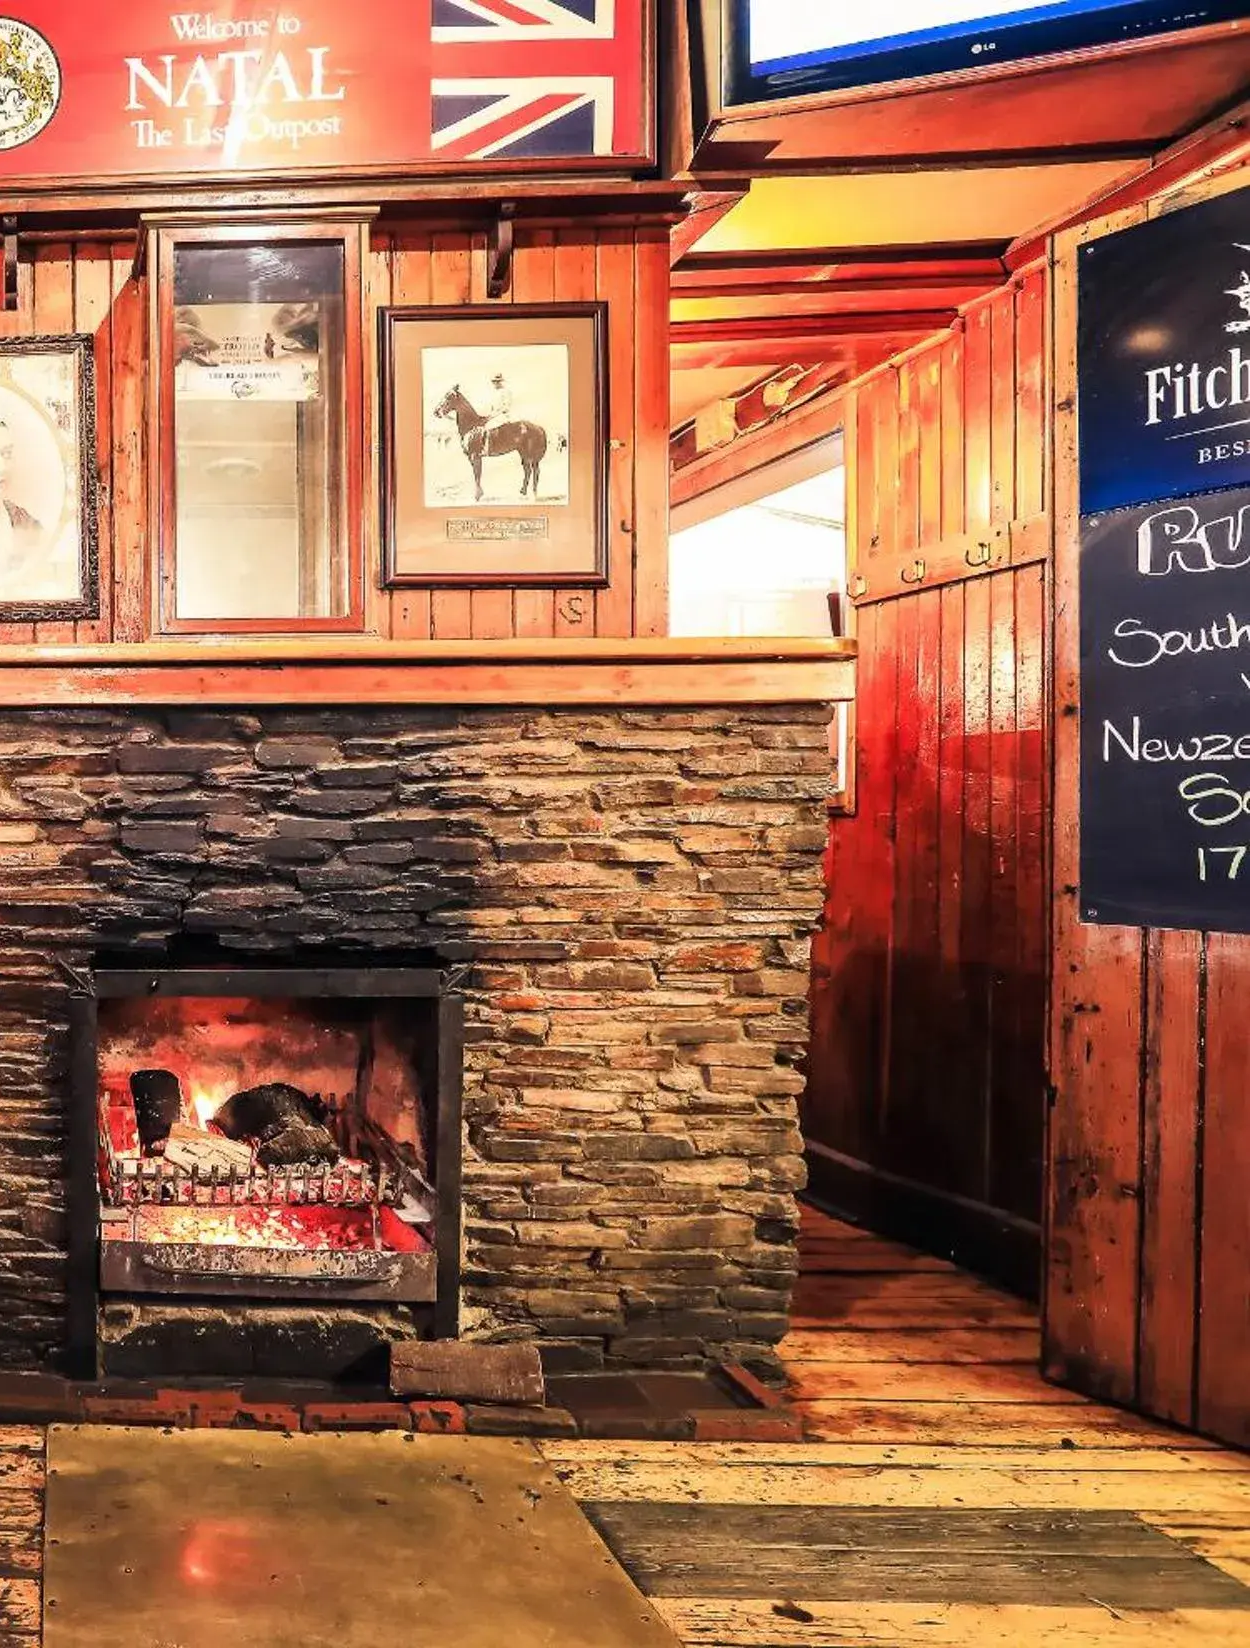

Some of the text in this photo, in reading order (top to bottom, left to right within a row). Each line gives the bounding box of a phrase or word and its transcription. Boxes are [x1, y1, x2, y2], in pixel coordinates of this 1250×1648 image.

[170, 12, 301, 41] Welcome to
[124, 46, 347, 111] NATAL
[130, 119, 172, 149] The
[244, 113, 342, 149] Outpost
[1197, 439, 1250, 465] BES
[1177, 772, 1250, 826] S
[1197, 845, 1247, 881] 17
